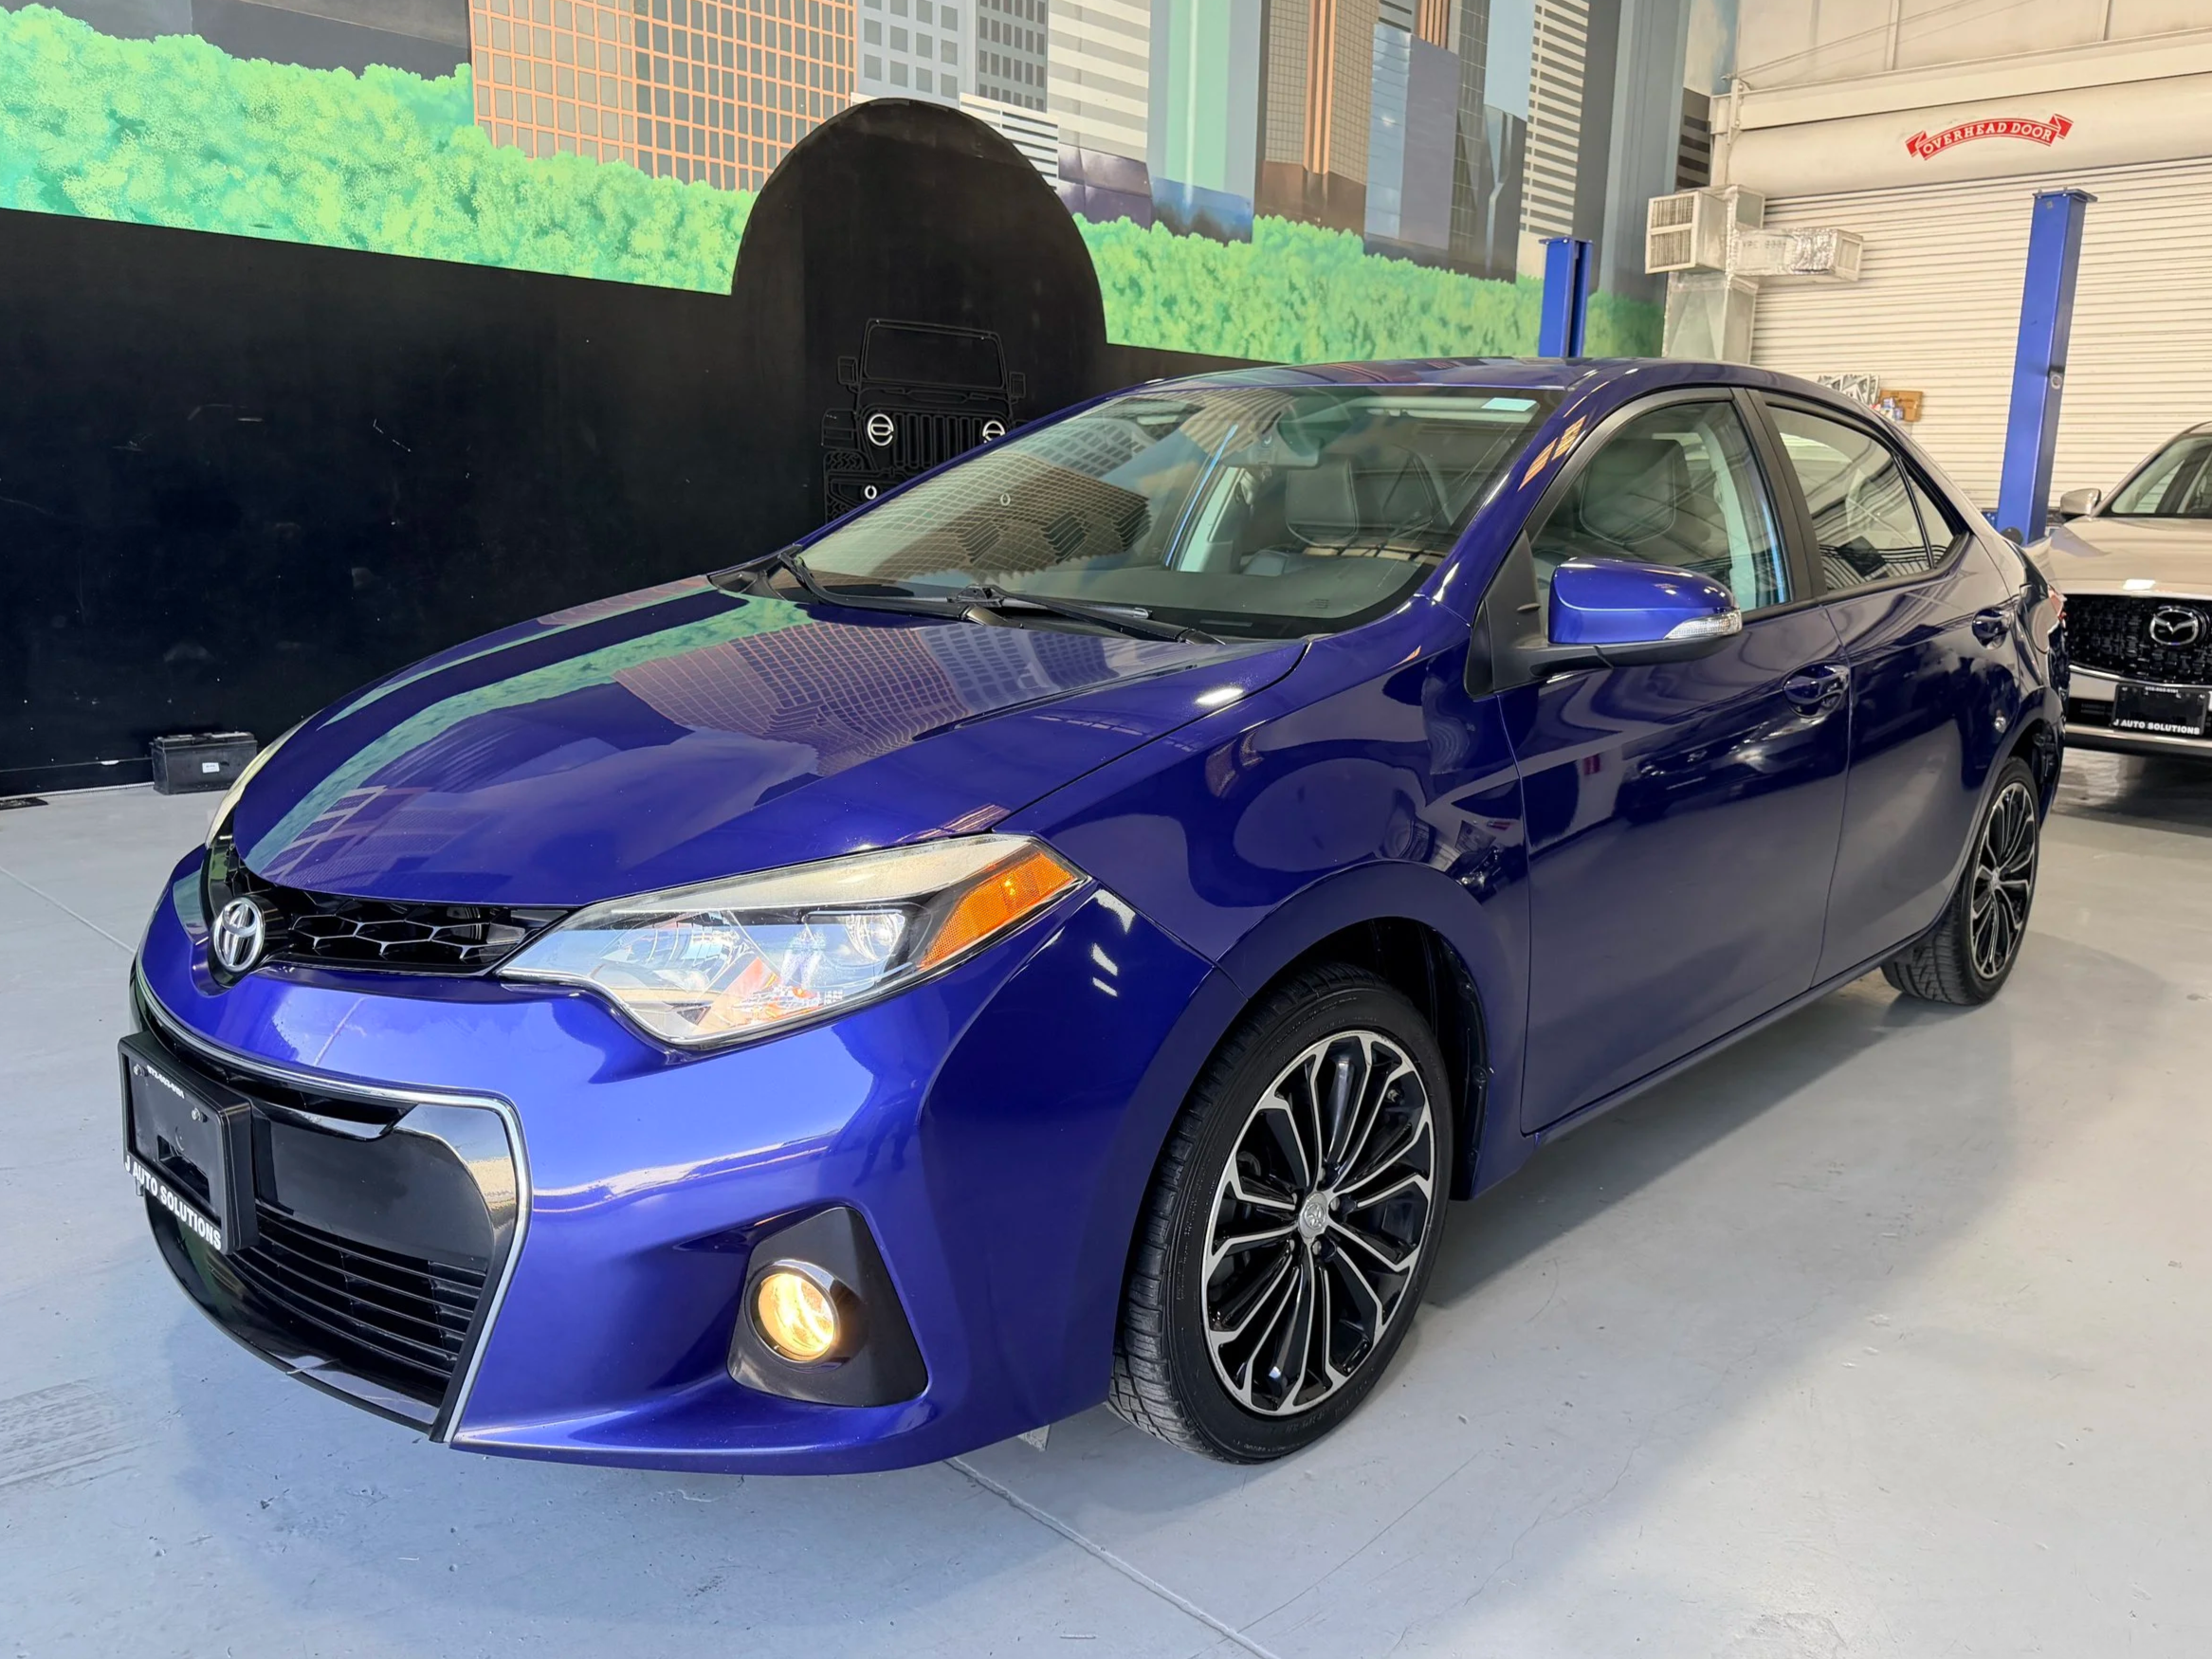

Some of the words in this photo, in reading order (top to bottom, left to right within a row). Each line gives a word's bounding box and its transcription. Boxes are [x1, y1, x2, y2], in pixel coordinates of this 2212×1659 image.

[1923, 122, 2007, 154] OVERHEAD
[2010, 122, 2053, 143] DOOR
[2120, 720, 2146, 729] AUTO
[2148, 722, 2201, 736] SOLUTIONS
[125, 1155, 131, 1172] J
[132, 1161, 158, 1196] AUTO
[159, 1185, 222, 1250] SOLUTIONS
